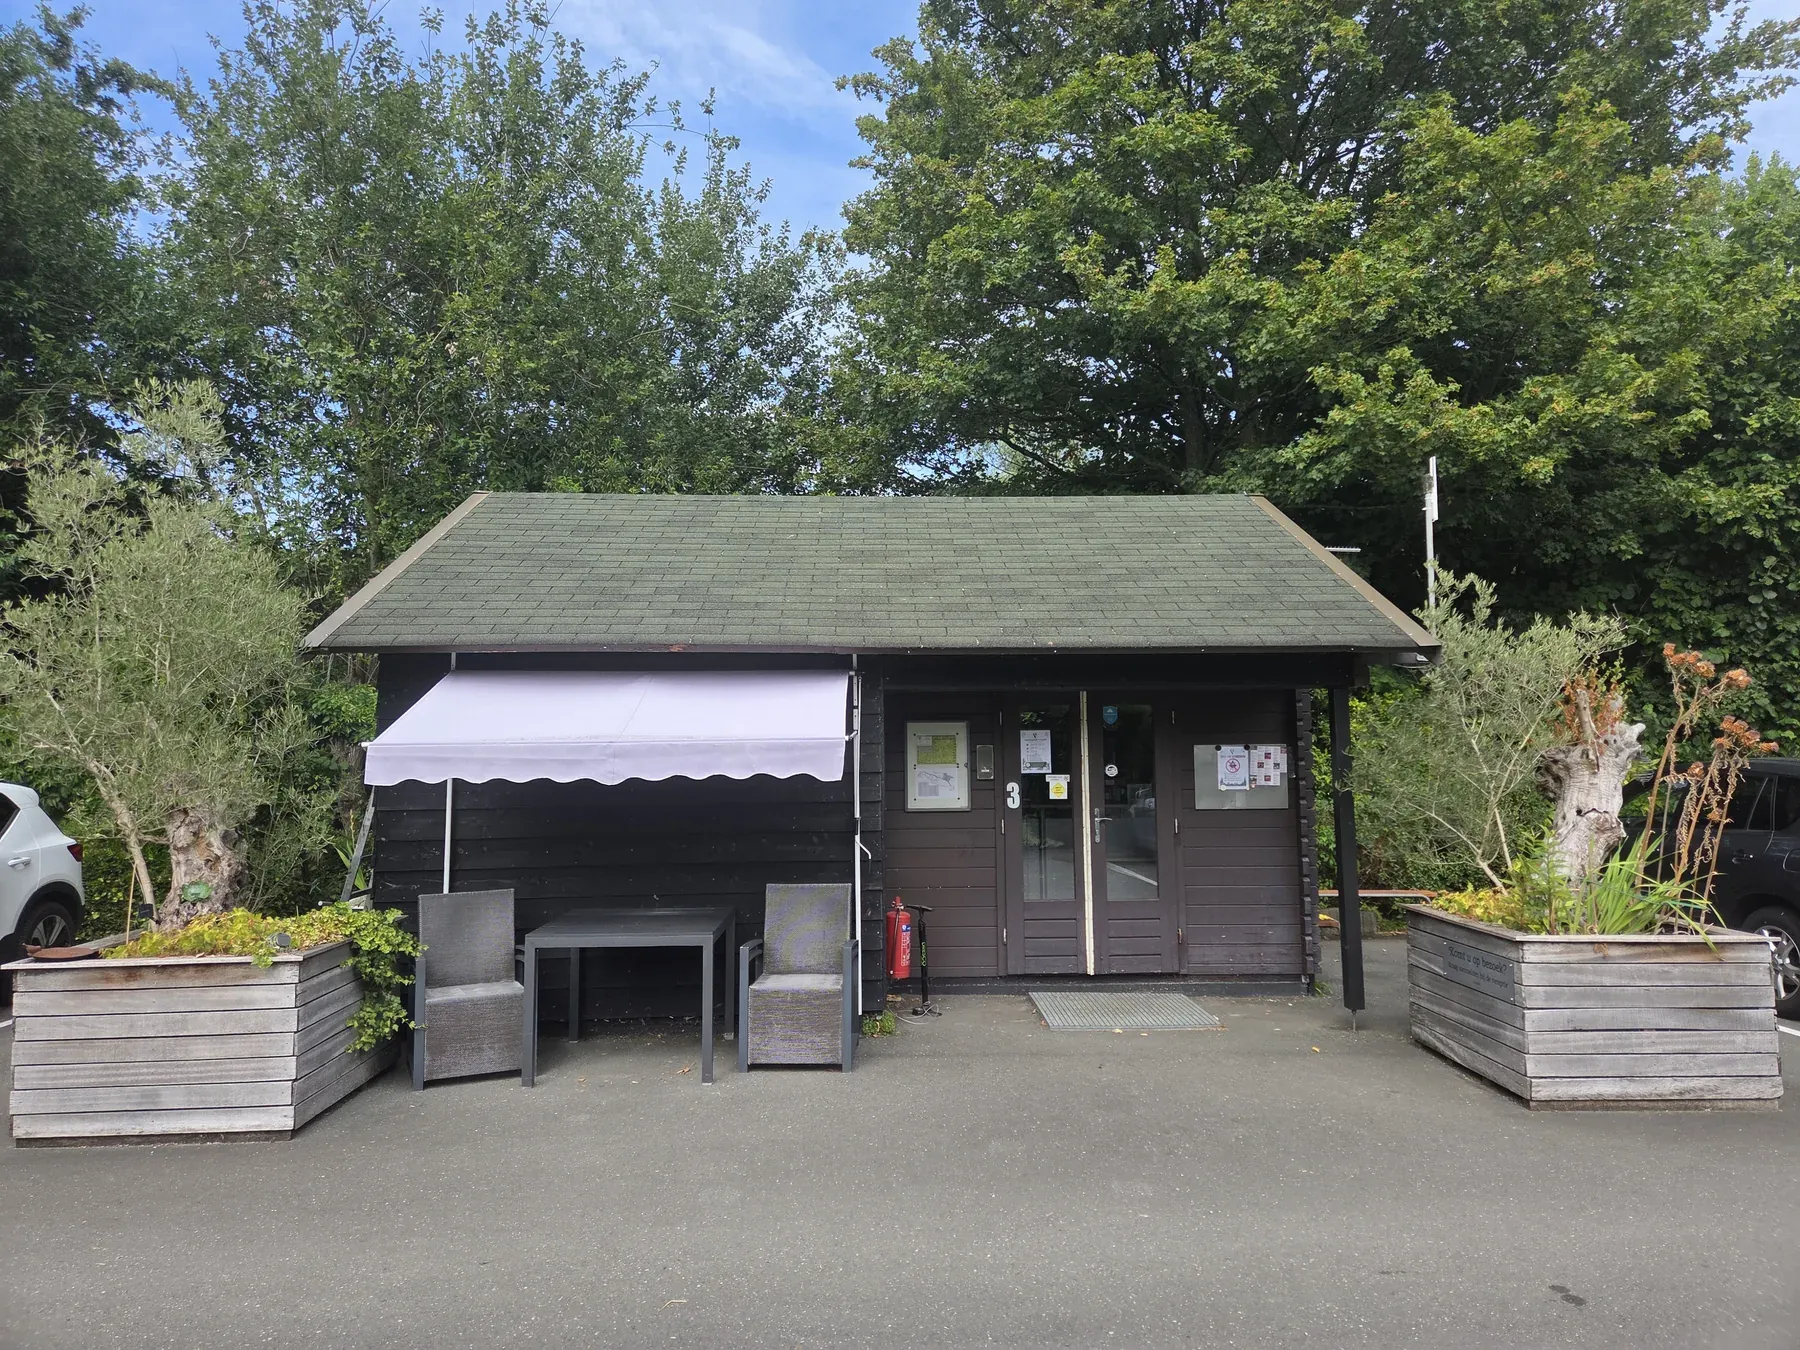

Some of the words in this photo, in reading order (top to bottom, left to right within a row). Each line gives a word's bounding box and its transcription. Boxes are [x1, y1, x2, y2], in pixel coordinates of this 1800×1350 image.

[1006, 782, 1020, 809] 3
[1448, 946, 1466, 961] Komt
[1466, 954, 1472, 963] u
[1472, 956, 1481, 968] op
[1481, 955, 1507, 975] bezoek?
